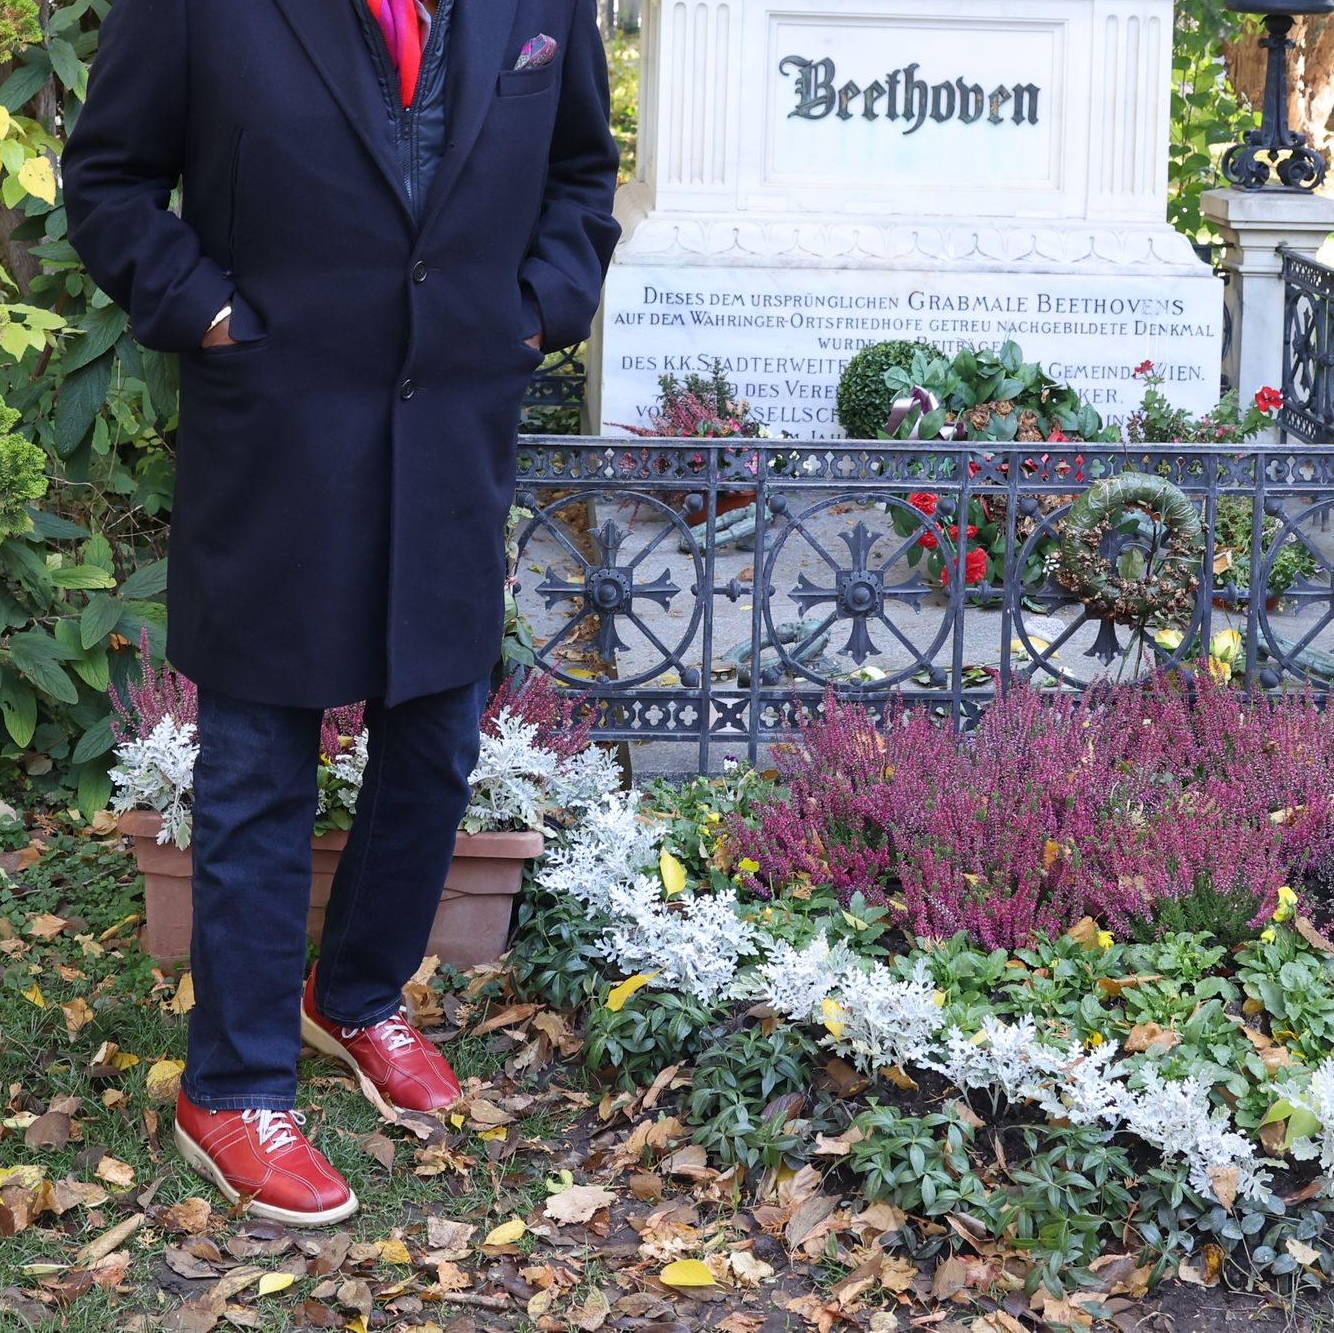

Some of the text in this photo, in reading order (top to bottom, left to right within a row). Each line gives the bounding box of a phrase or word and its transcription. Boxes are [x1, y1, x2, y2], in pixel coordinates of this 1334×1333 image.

[779, 54, 1042, 135] Beethoven
[709, 293, 745, 307] DEM
[614, 312, 644, 326] AUF
[649, 312, 685, 326] DEM
[929, 319, 992, 333] GETREU
[621, 355, 657, 371] DES
[745, 383, 780, 398] DES
